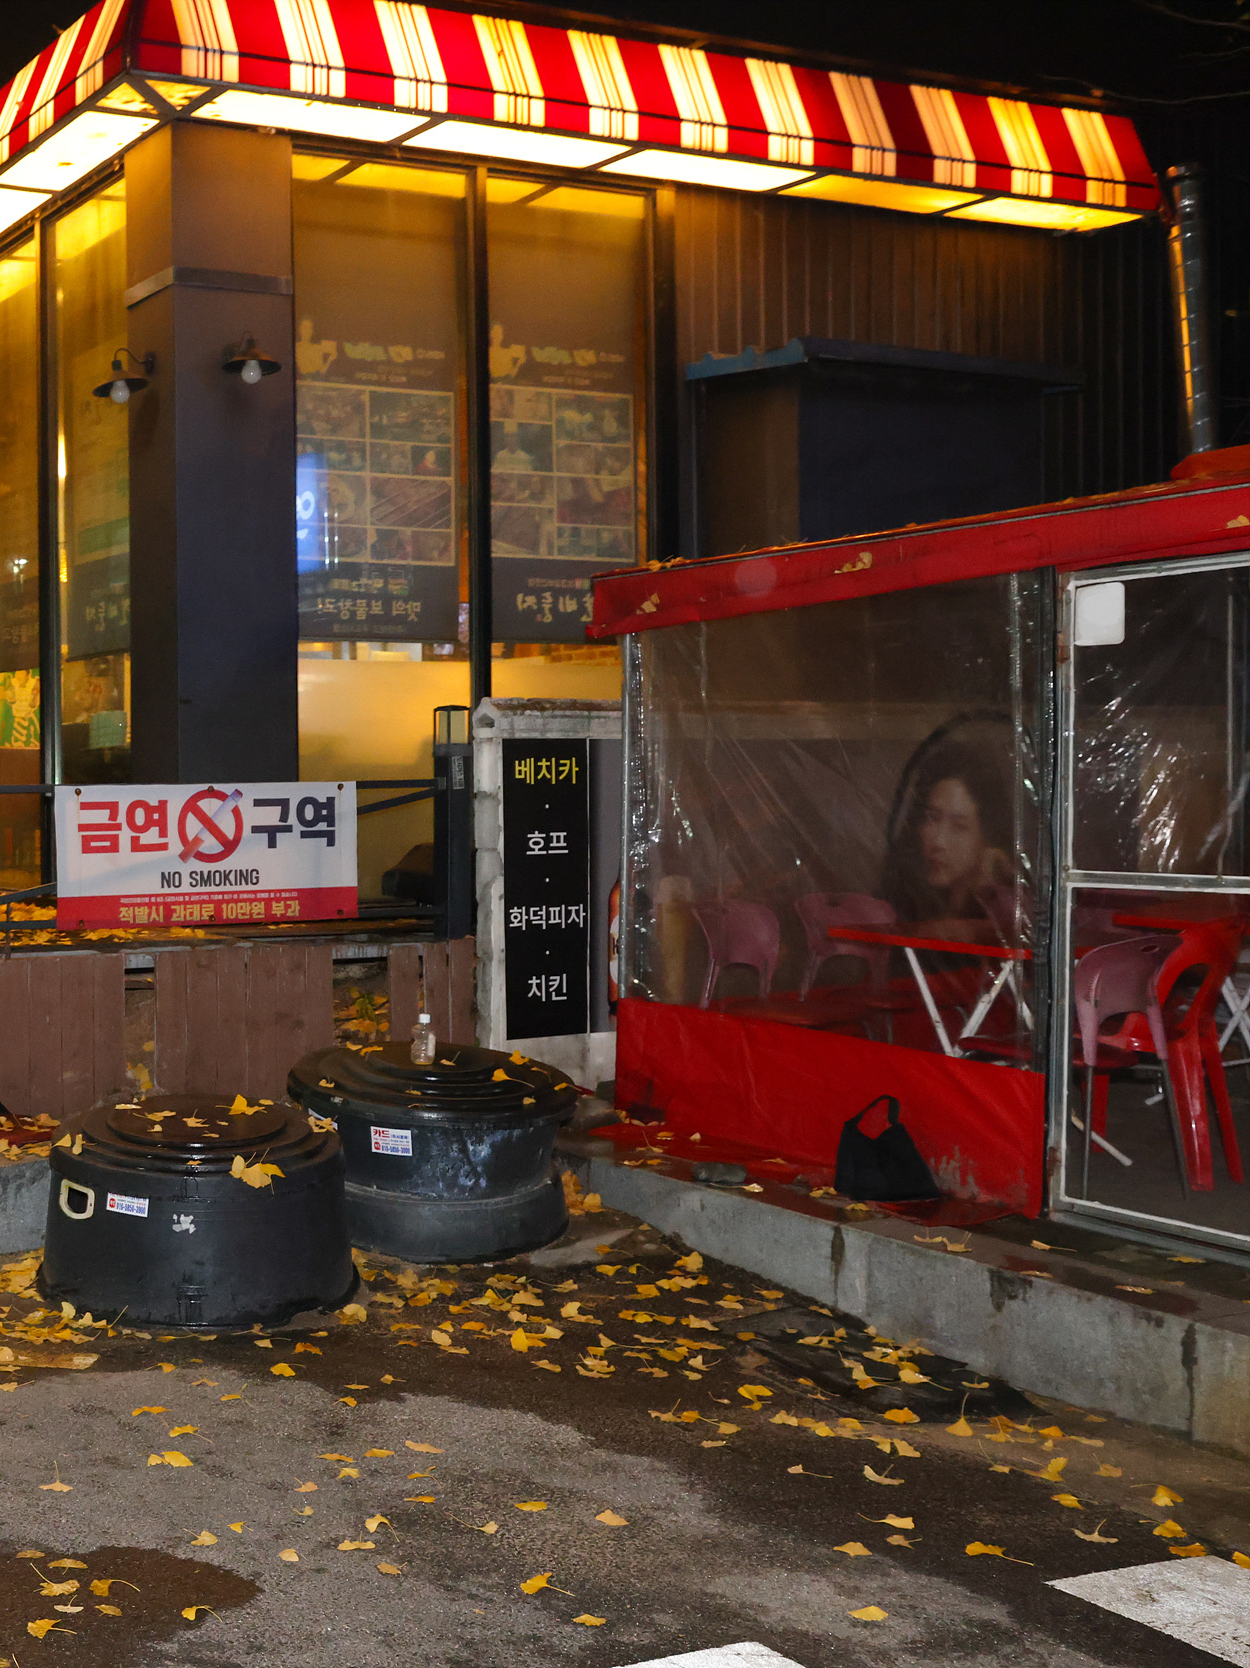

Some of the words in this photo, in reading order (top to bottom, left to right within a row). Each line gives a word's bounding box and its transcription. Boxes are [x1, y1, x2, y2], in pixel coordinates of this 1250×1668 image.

[514, 757, 579, 785] 베치카
[78, 799, 169, 854] 금연
[251, 796, 336, 848] 구역
[526, 830, 569, 856] 호프
[161, 871, 183, 889] NO
[189, 868, 260, 888] SMOKING
[119, 905, 164, 924] 적발시
[221, 901, 265, 919] 10만원
[271, 900, 300, 917] 부과
[509, 903, 586, 930] 화덕피자
[527, 973, 568, 1002] 치킨
[373, 1128, 390, 1138] 카드
